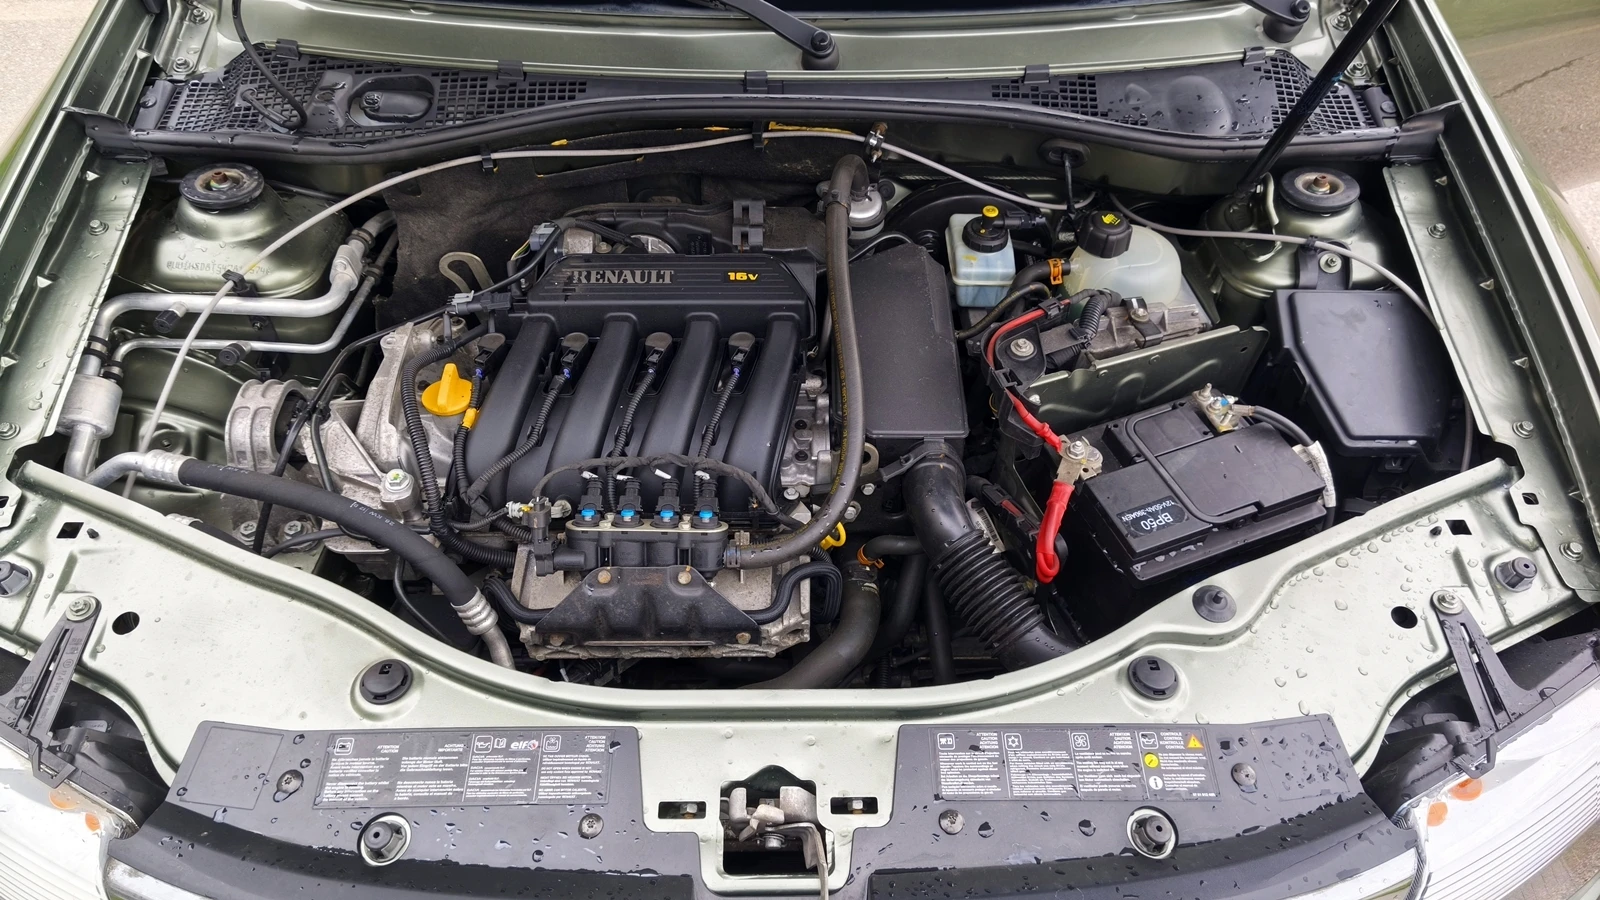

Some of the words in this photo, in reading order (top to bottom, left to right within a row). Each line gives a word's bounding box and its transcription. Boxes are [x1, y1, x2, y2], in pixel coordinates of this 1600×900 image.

[573, 270, 674, 284] RENAULT
[1141, 513, 1173, 530] BP50
[510, 740, 528, 749] elf
